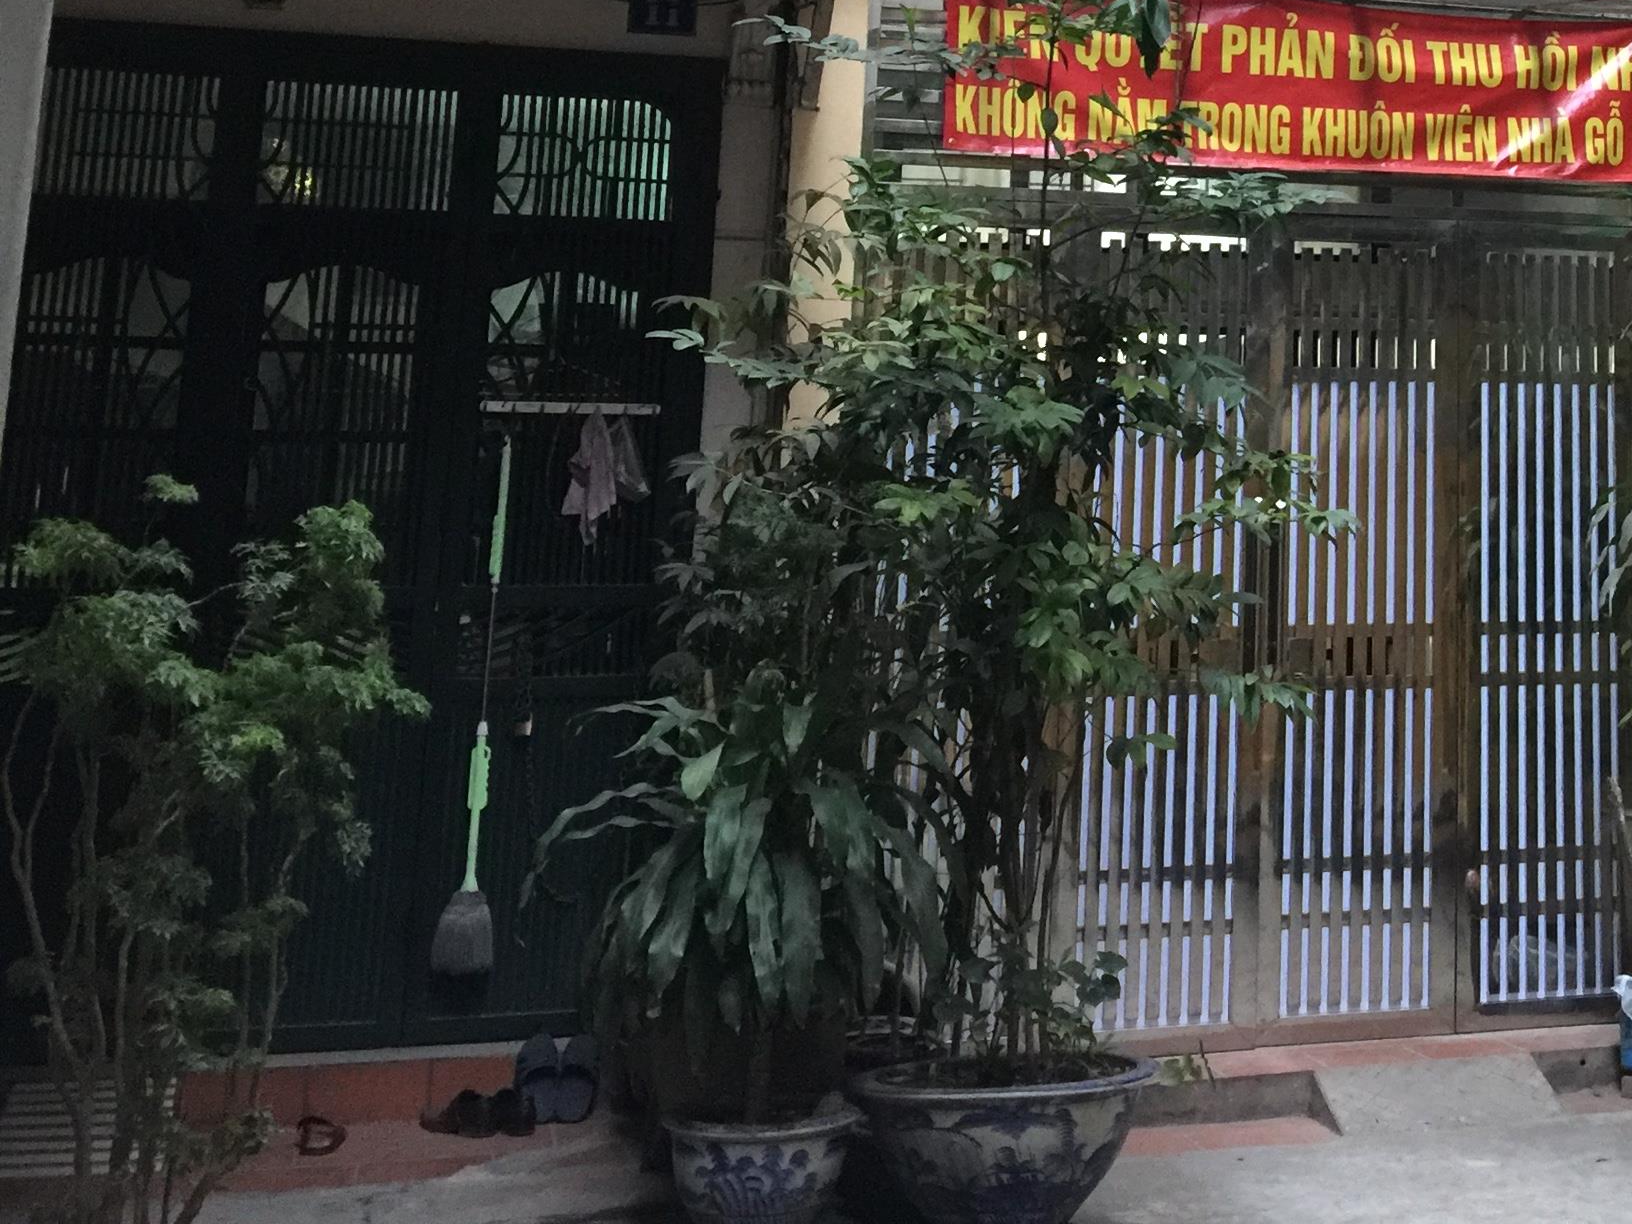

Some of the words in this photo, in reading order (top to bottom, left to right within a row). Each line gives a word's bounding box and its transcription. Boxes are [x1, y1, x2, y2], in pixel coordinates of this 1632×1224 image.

[1221, 12, 1335, 80] PHẢN
[1347, 22, 1416, 85] ĐỐI
[1426, 40, 1503, 89] THU
[1513, 30, 1580, 92] HỒI
[955, 76, 1077, 142] KHÔNG
[1179, 100, 1291, 156] TRONG
[1302, 100, 1415, 161] KHUÔN
[1425, 104, 1498, 163] VIÊN
[1506, 107, 1576, 165] NHÀ
[1584, 100, 1625, 167] GỖ
